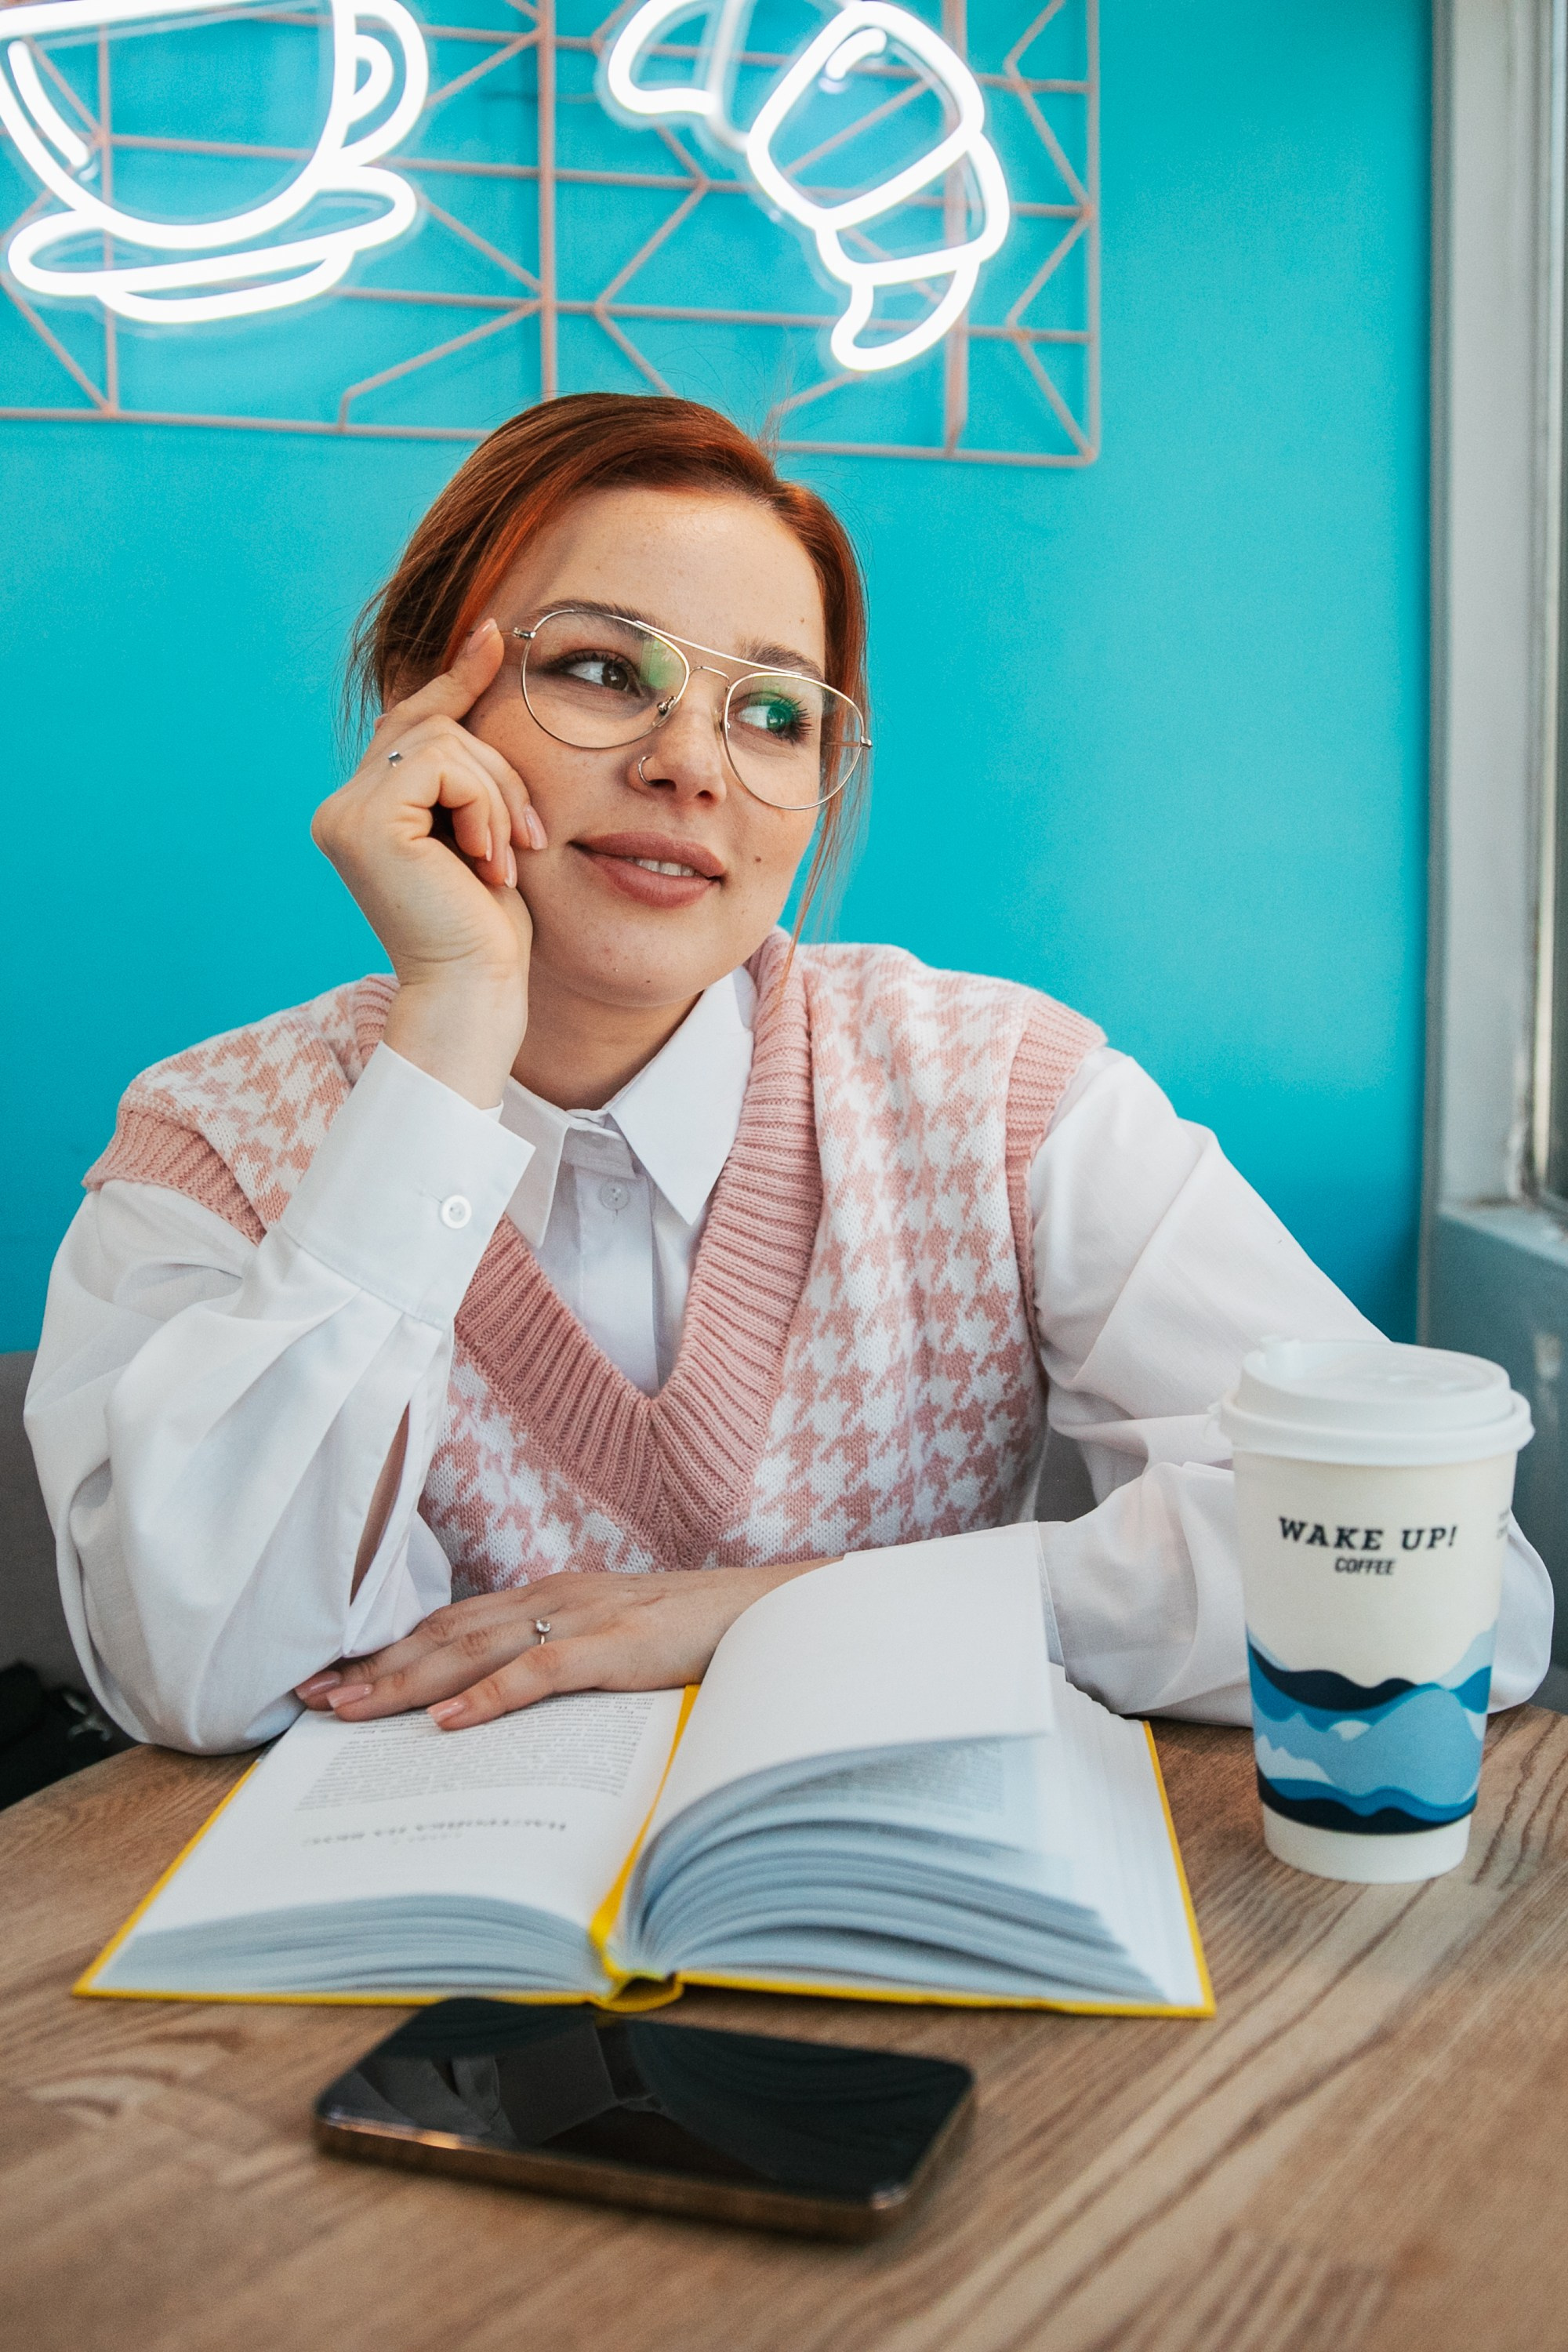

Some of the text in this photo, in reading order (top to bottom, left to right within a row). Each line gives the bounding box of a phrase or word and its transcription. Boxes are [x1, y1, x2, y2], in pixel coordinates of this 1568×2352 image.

[1279, 1516, 1457, 1551] WAKE UP!
[1334, 1556, 1395, 1575] COFFEE
